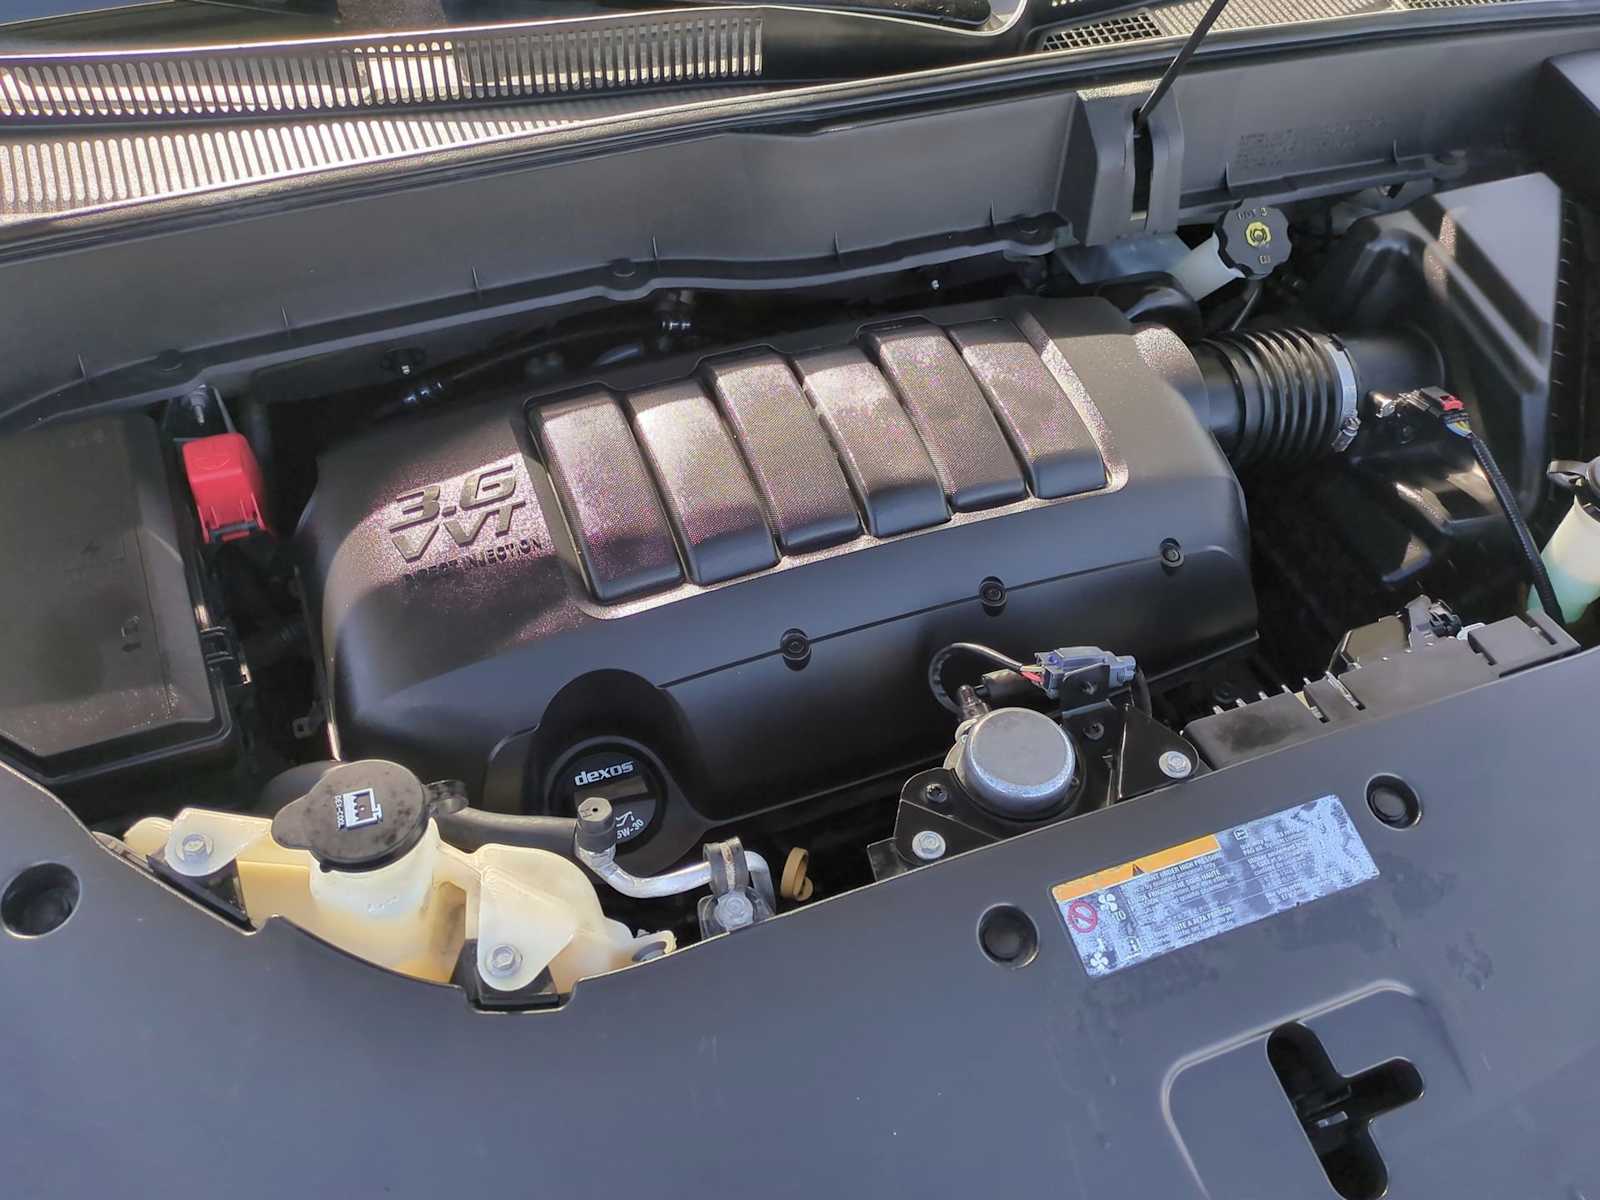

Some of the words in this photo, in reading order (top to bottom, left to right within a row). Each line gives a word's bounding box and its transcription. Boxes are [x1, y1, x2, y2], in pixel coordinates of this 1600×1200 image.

[388, 464, 517, 533] 3.6
[391, 500, 526, 563] VVT
[574, 761, 634, 786] dexos
[616, 819, 644, 840] 5W-30
[1200, 868, 1221, 880] HAUTE
